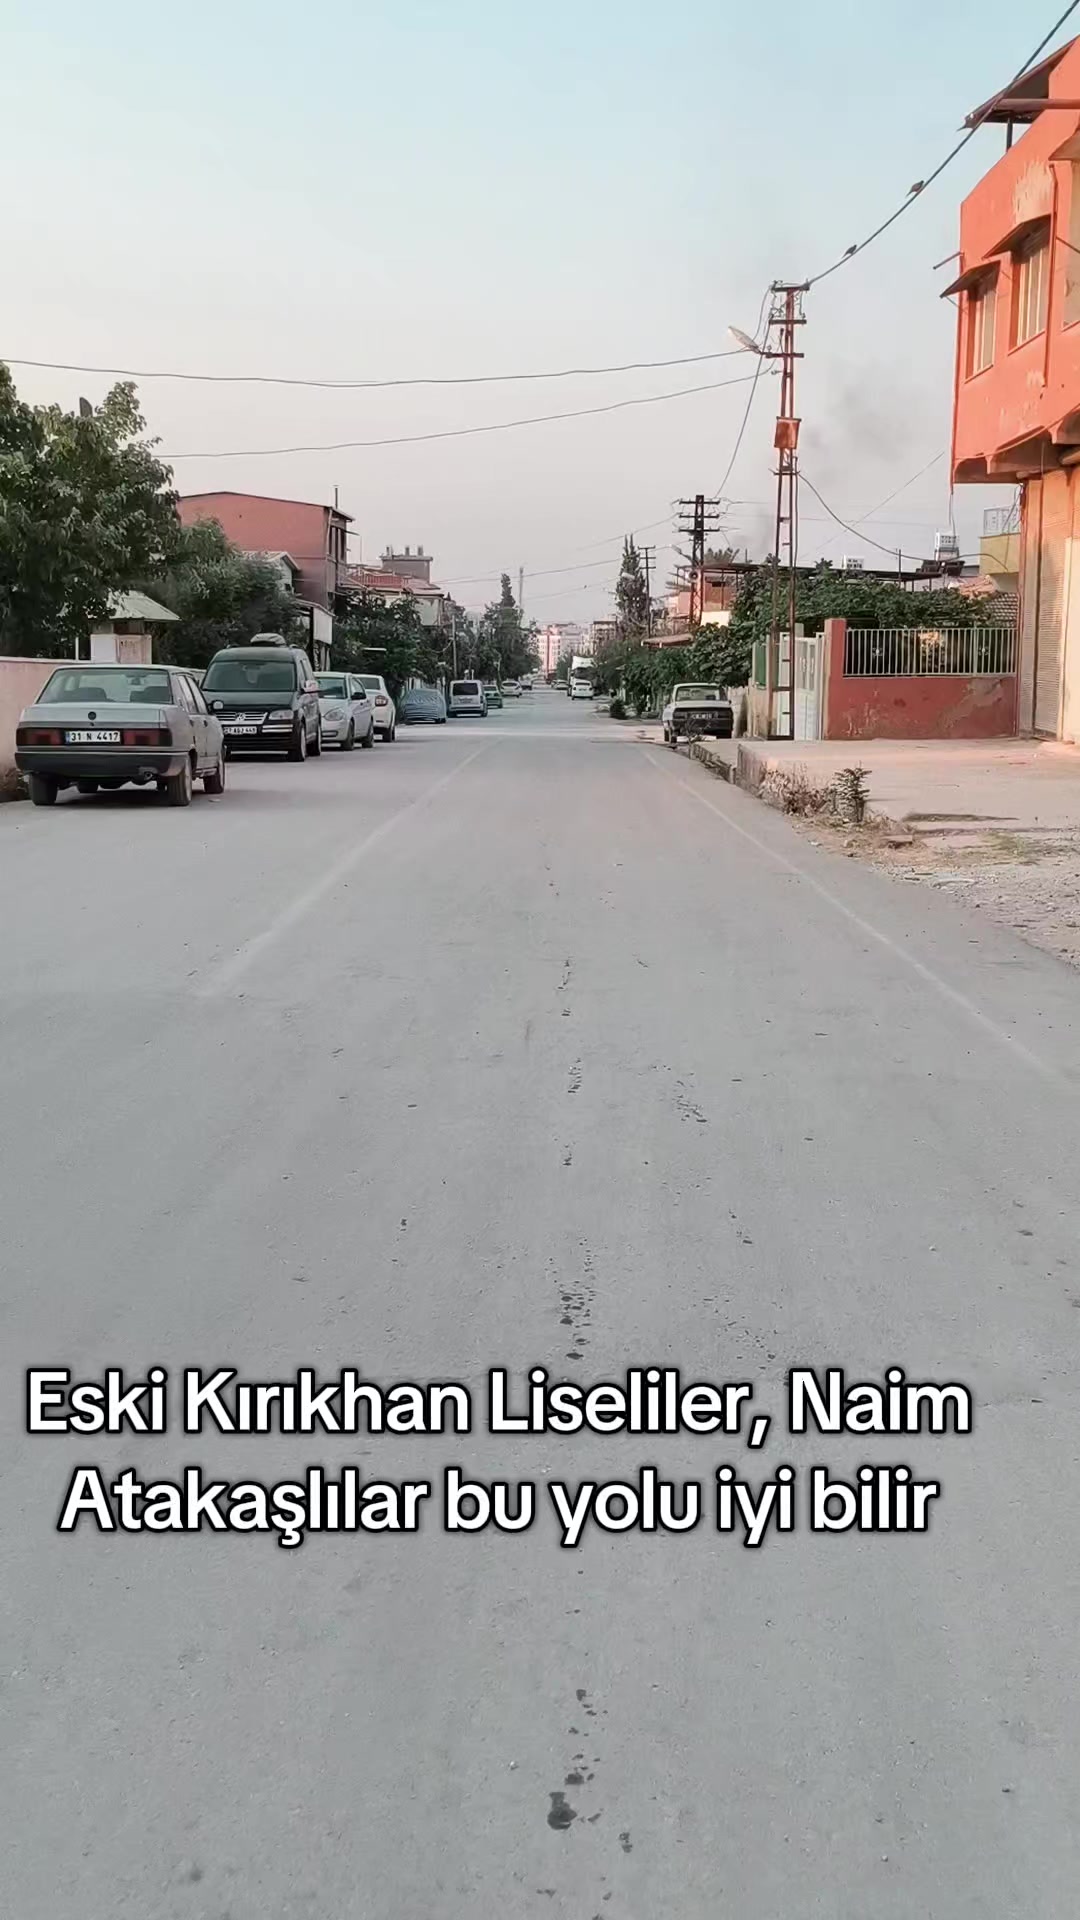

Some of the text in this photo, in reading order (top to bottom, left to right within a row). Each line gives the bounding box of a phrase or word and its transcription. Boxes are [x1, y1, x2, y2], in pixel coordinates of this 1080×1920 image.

[71, 732, 119, 741] 31 N 4417
